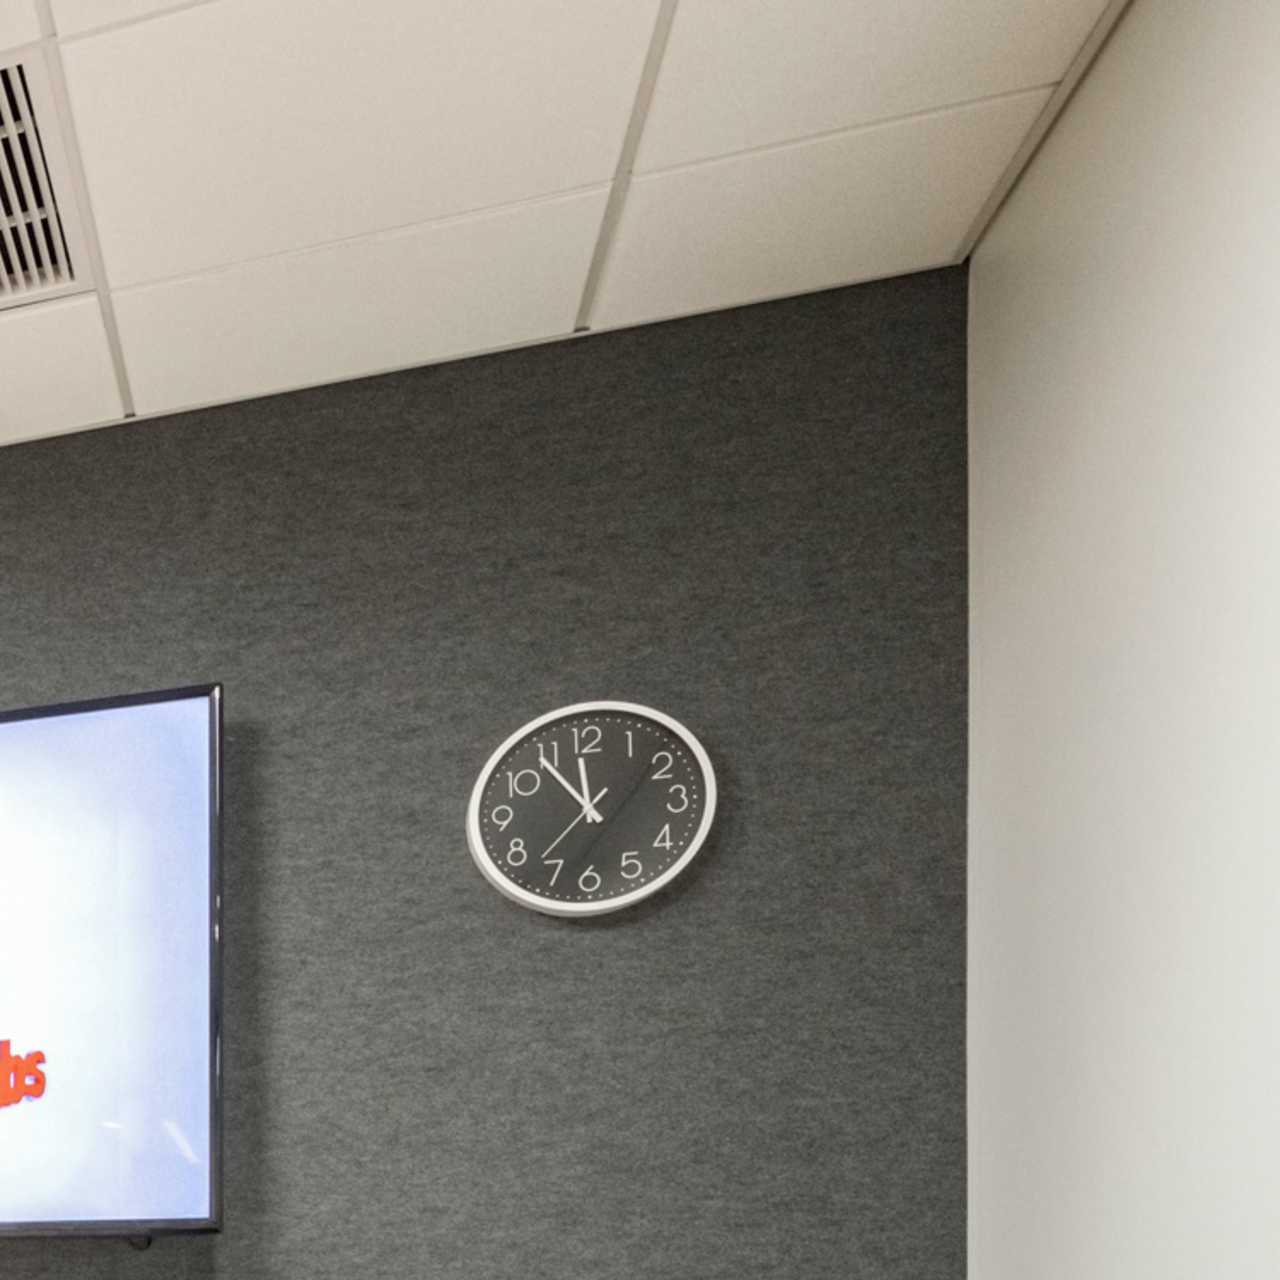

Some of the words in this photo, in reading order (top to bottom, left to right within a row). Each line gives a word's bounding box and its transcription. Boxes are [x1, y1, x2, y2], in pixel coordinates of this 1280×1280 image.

[571, 725, 602, 754] 12
[625, 731, 633, 758] 1
[537, 741, 558, 769] 11
[651, 752, 673, 780] 2
[506, 769, 541, 798] 10
[666, 784, 689, 813] 3
[491, 805, 513, 832] 9
[653, 824, 674, 850] 4
[506, 838, 527, 866] 8
[620, 851, 643, 879] 5
[543, 859, 564, 886] 7
[578, 864, 601, 892] 6
